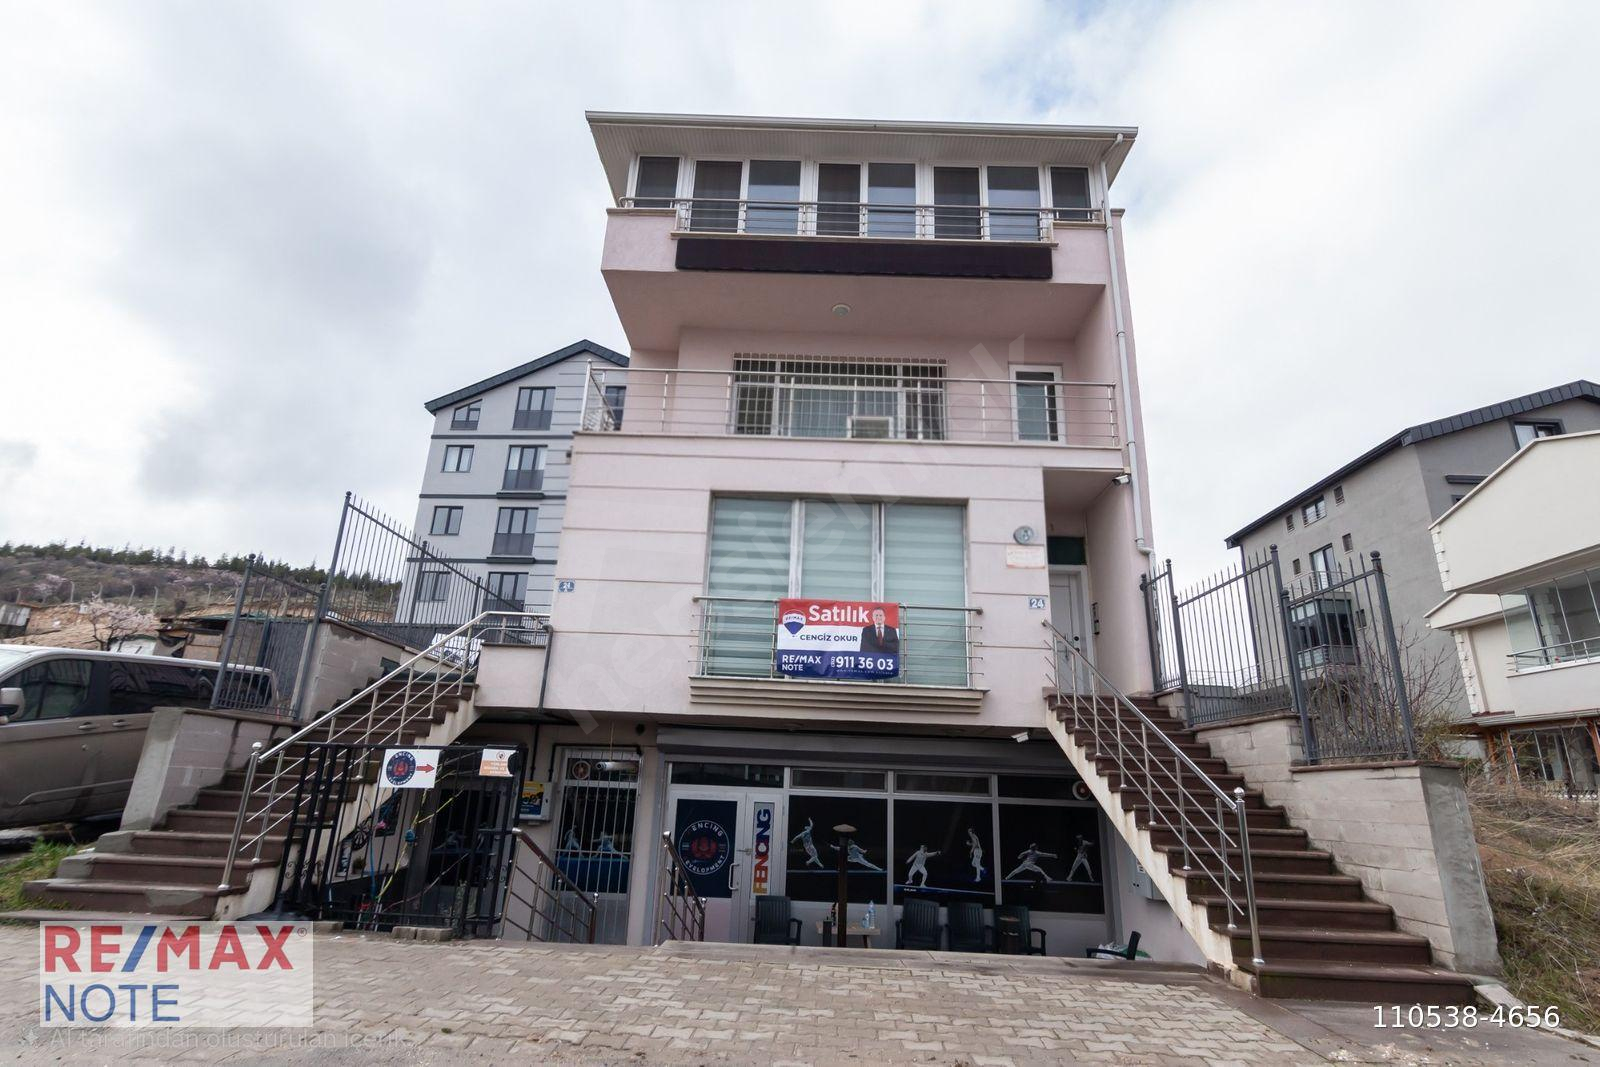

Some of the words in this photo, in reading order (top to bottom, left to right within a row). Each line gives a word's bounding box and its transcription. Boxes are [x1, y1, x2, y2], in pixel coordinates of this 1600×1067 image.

[1031, 598, 1044, 608] 24
[808, 604, 870, 623] Satılık
[799, 632, 832, 642] CENGİZ
[782, 655, 822, 664] RE/MAX
[836, 656, 855, 668] 911
[858, 657, 874, 669] 36
[877, 659, 894, 671] 03
